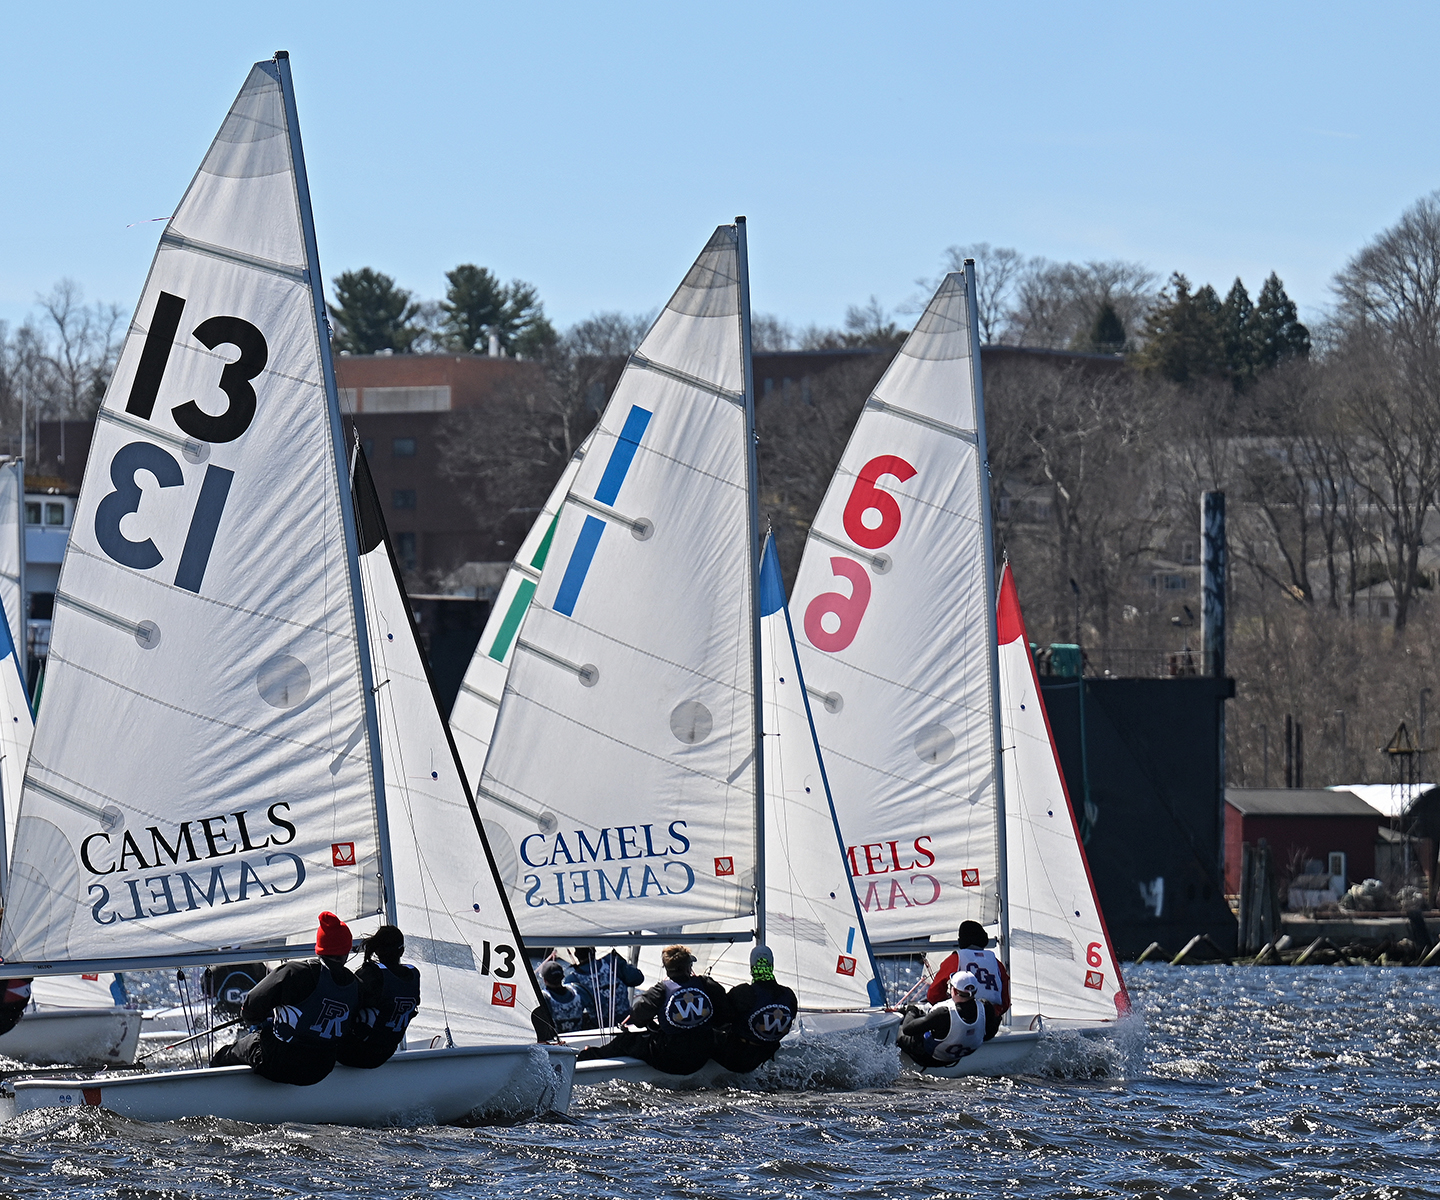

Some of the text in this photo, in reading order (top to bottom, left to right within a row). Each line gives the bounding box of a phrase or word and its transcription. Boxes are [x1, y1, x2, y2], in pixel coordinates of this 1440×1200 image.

[124, 290, 270, 445] 13
[593, 404, 652, 507] 1
[843, 454, 918, 550] 6
[80, 801, 296, 875] CAMELS
[520, 820, 690, 867] CAMELS
[481, 940, 516, 979] 13
[1086, 942, 1102, 967] 6
[674, 997, 704, 1019] W
[763, 1013, 791, 1033] W
